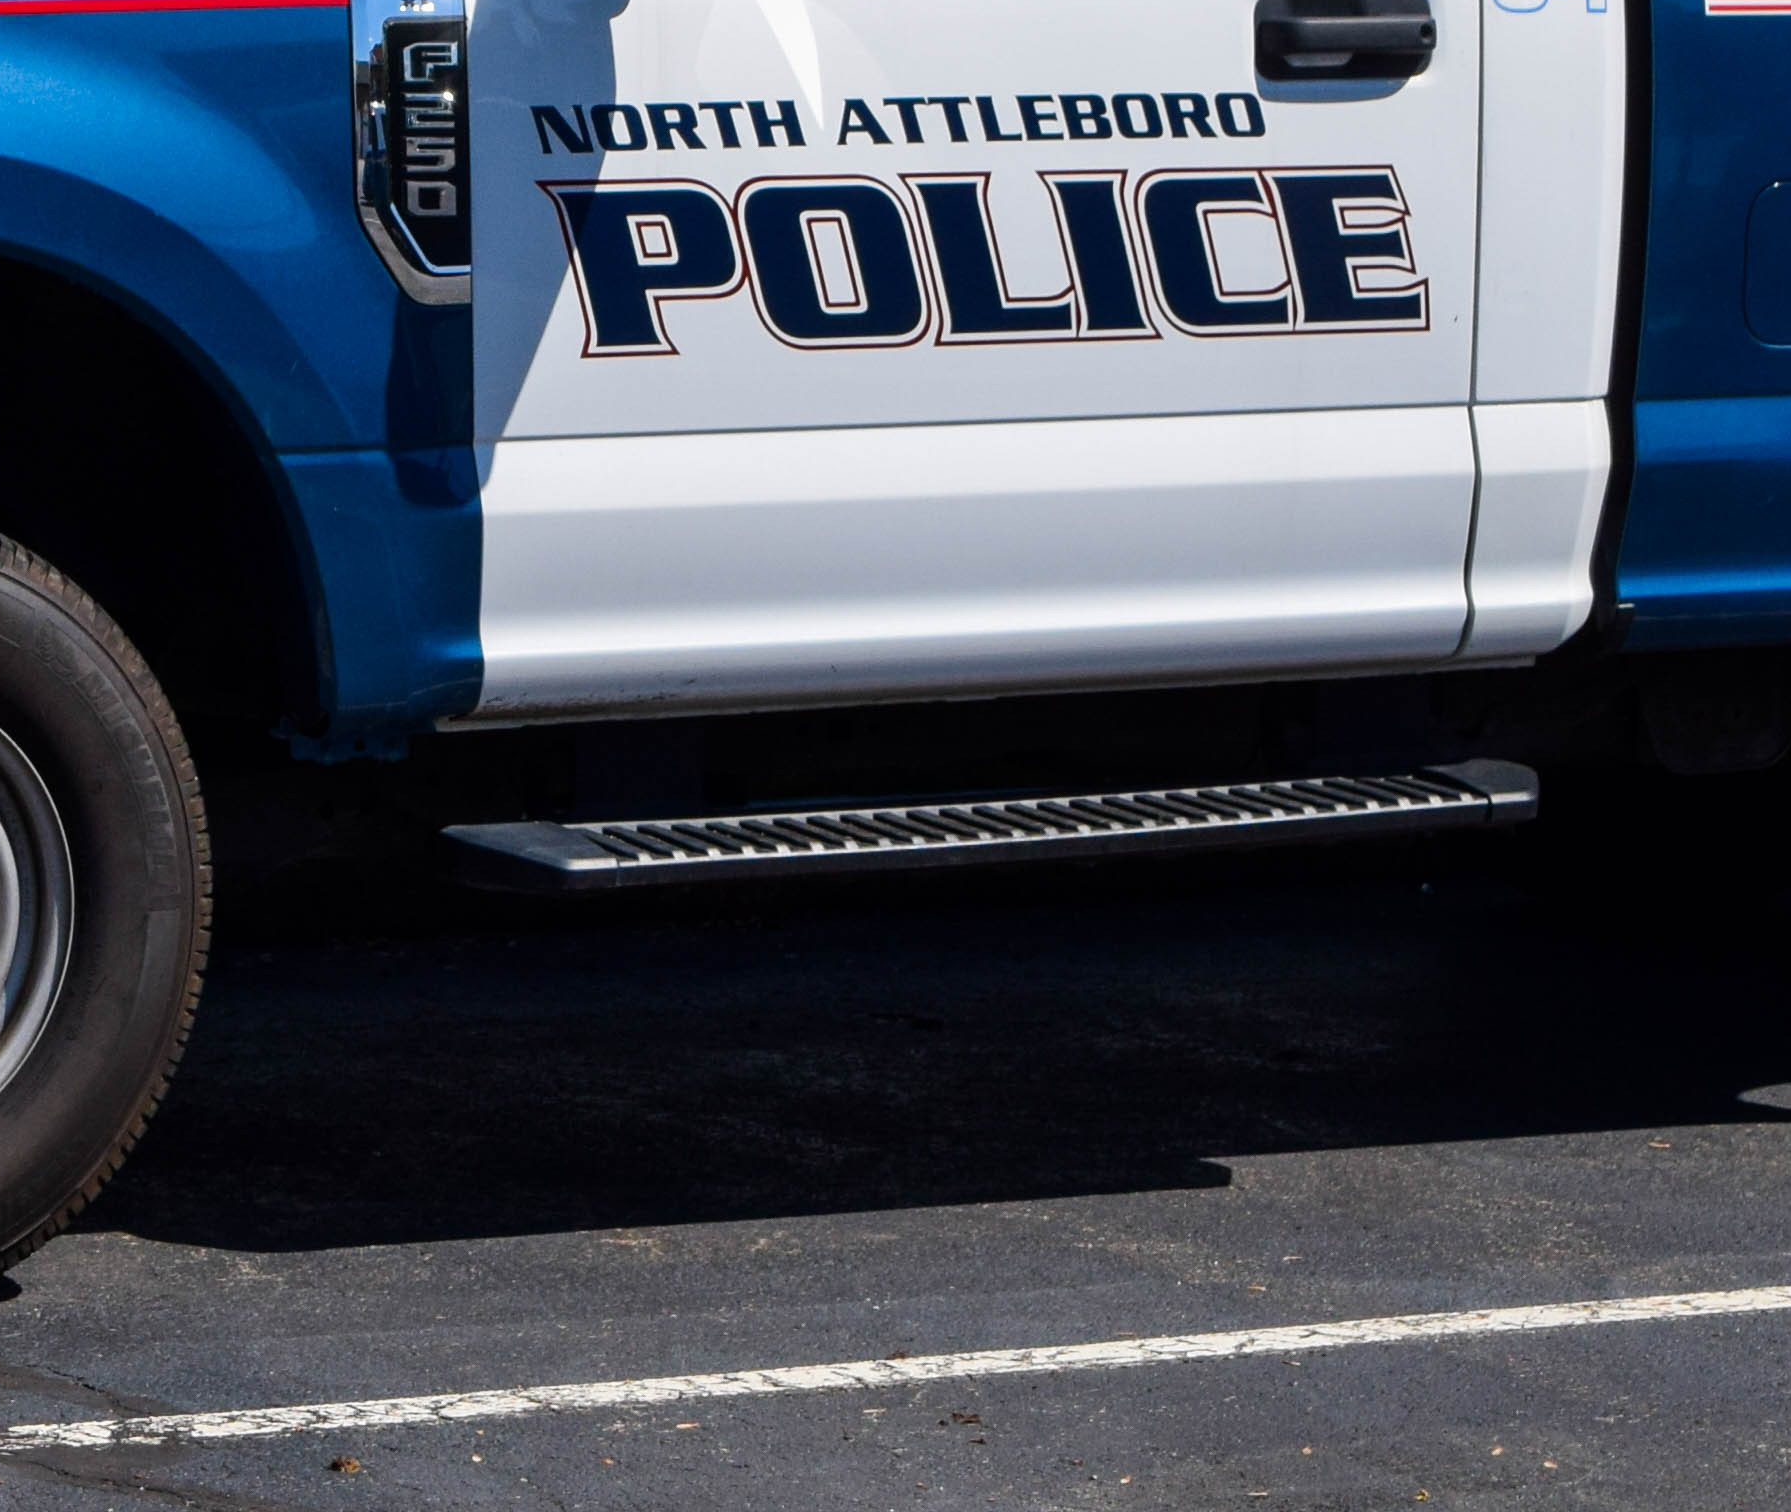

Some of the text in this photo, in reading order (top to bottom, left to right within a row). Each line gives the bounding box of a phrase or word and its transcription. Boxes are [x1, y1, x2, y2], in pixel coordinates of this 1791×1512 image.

[402, 41, 458, 217] F250
[531, 93, 1266, 155] NORTH ATTLEBORO
[536, 165, 1430, 358] POLICE
